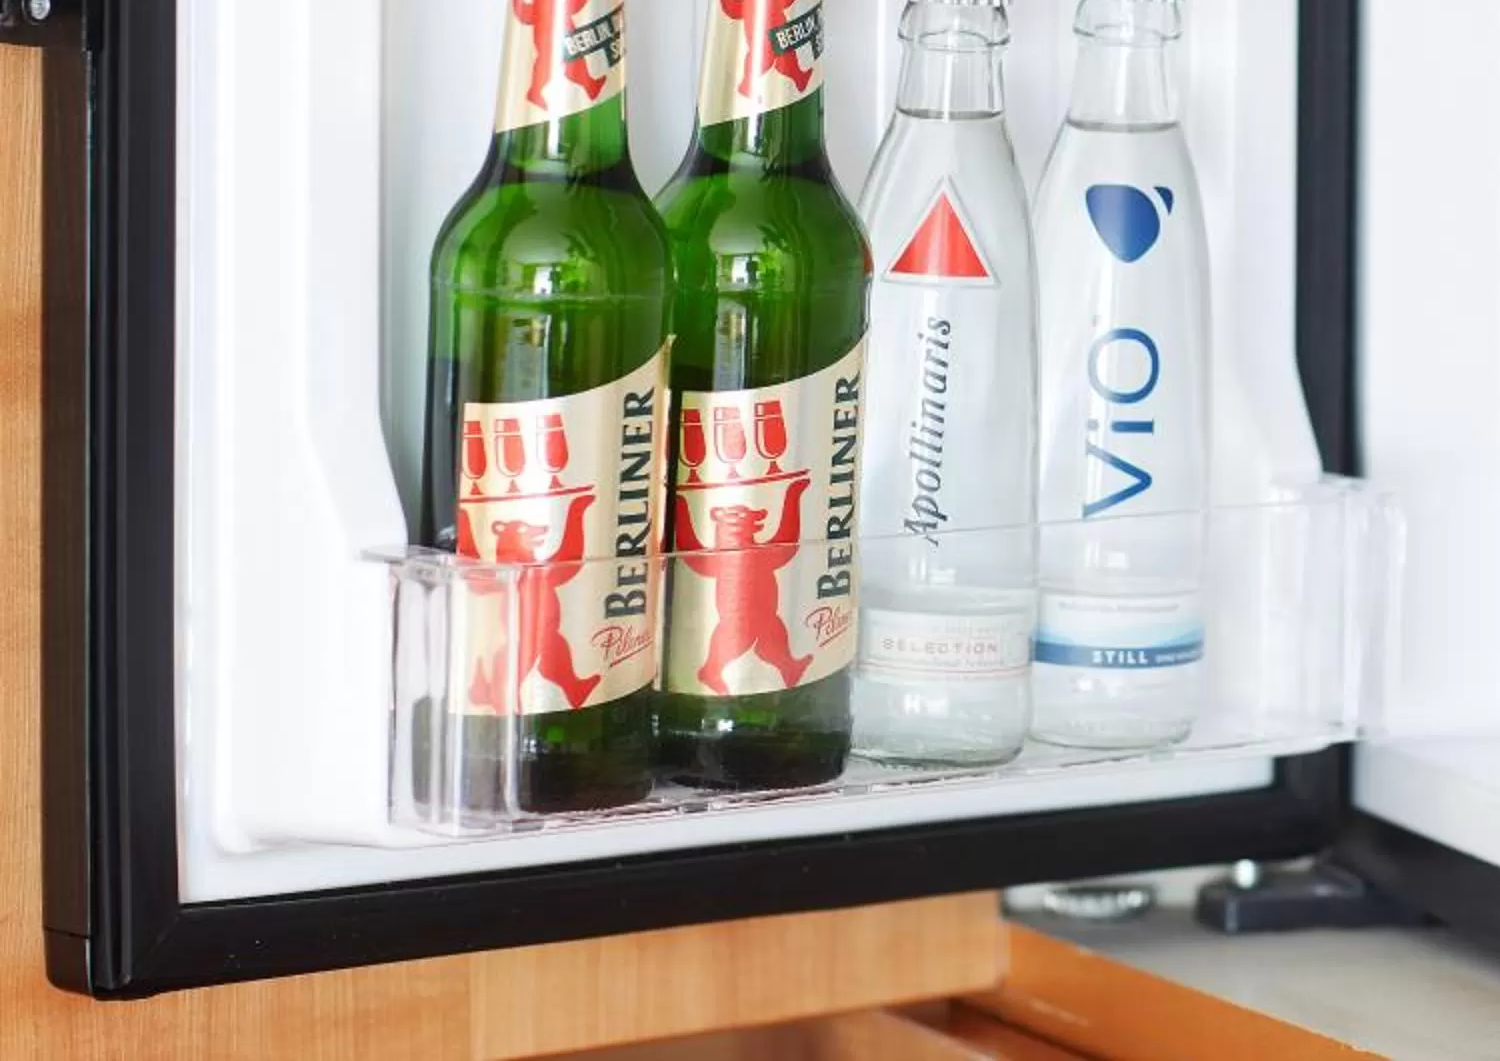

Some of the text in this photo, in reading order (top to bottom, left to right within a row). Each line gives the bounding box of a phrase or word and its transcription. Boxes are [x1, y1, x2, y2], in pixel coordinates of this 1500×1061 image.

[604, 386, 655, 619] BERLINER
[816, 370, 861, 600] BERLINER
[903, 316, 951, 548] Apollinaris
[881, 636, 999, 656] SELECTION
[1091, 650, 1149, 665] STILL
